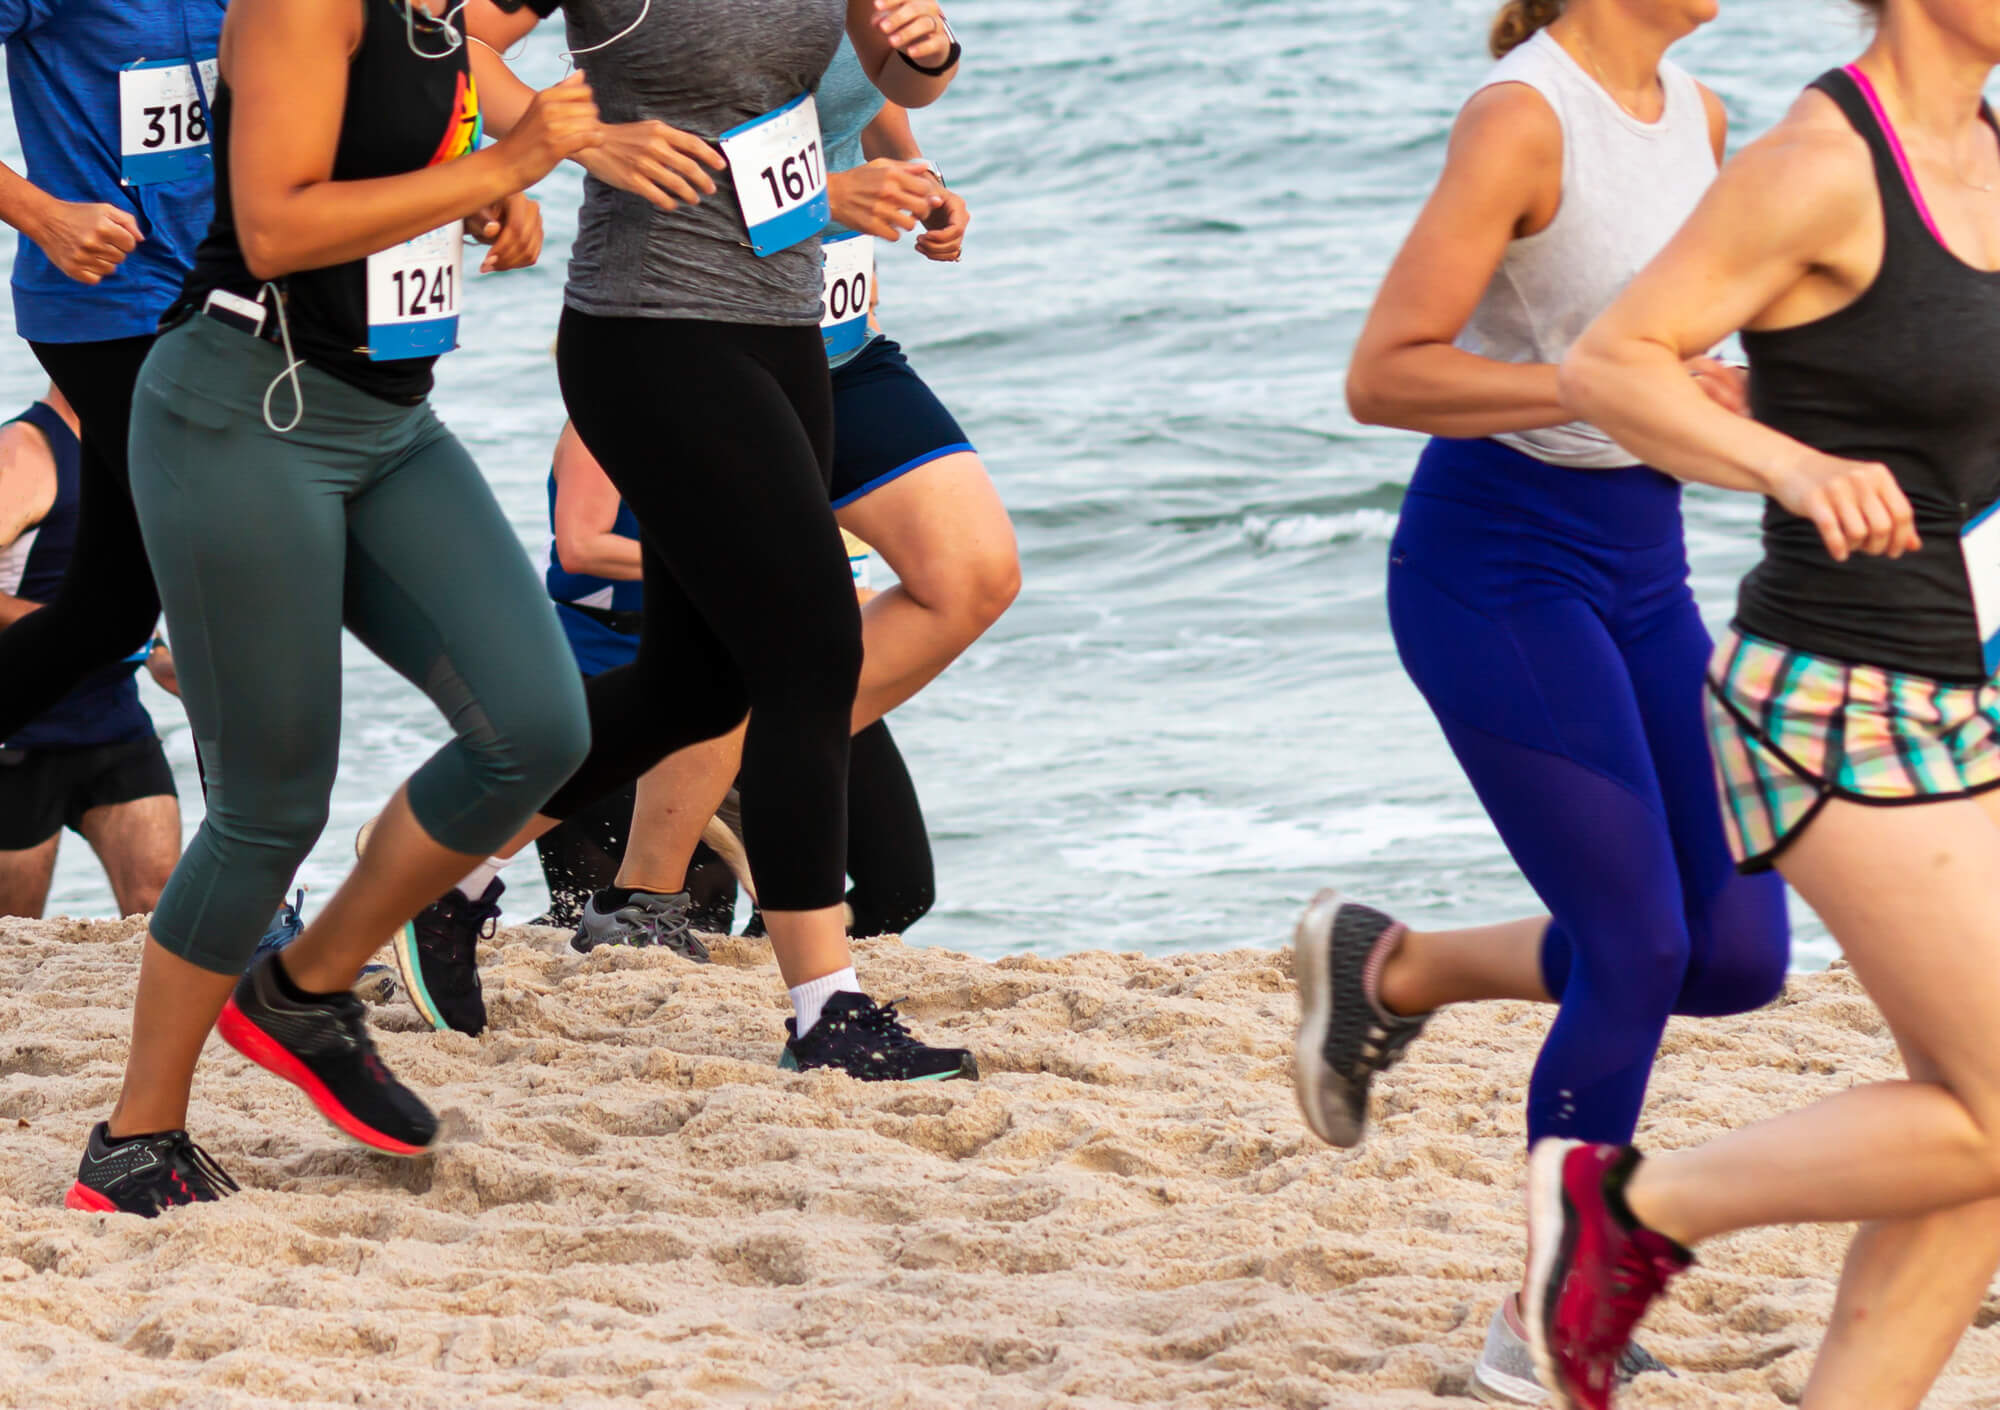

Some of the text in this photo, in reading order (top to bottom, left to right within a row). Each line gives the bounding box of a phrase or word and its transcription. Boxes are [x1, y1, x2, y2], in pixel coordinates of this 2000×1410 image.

[142, 100, 206, 148] 318
[760, 140, 820, 208] 1617
[391, 264, 453, 317] 1241
[823, 272, 866, 320] 00
